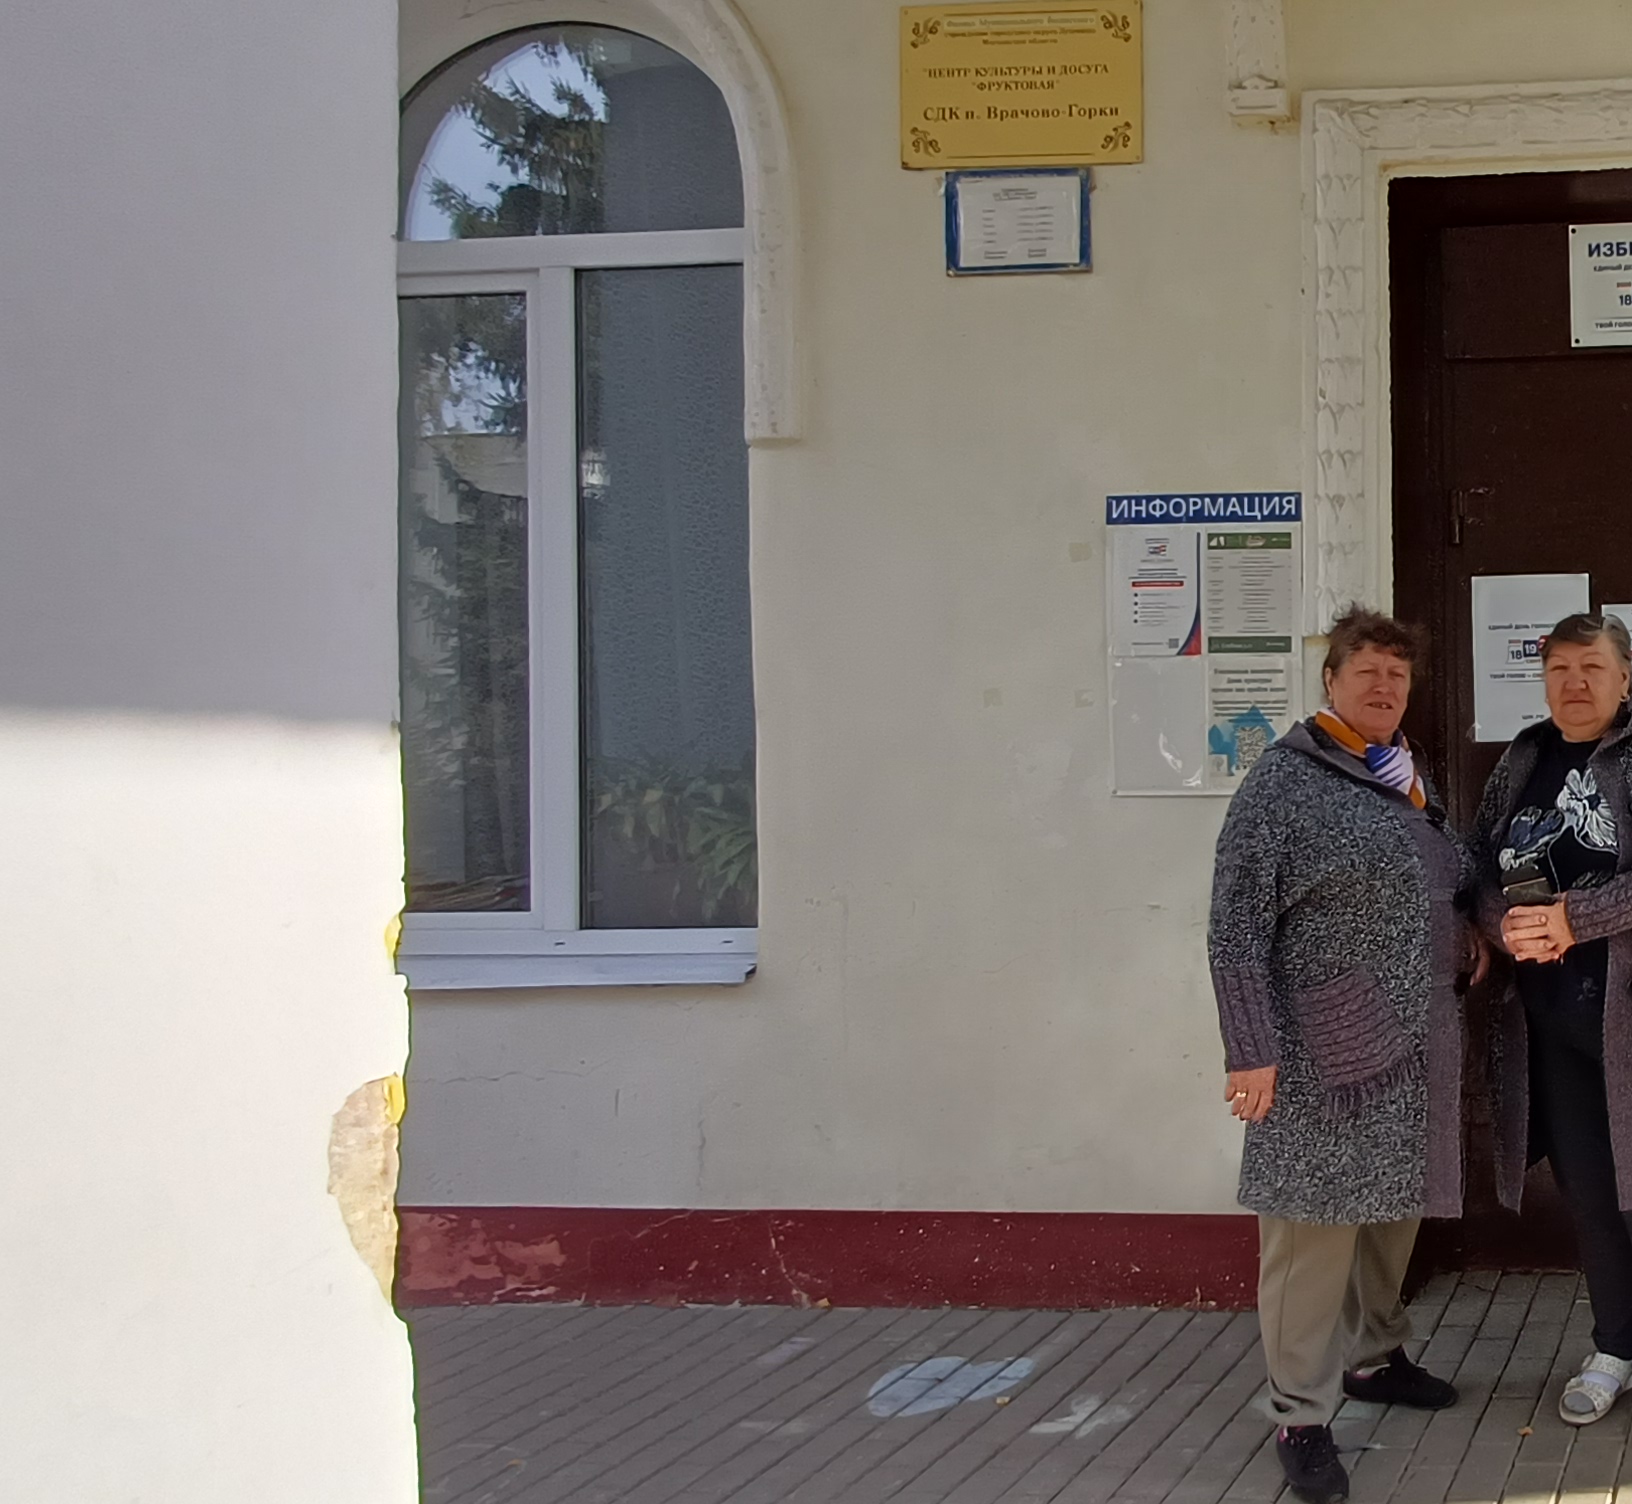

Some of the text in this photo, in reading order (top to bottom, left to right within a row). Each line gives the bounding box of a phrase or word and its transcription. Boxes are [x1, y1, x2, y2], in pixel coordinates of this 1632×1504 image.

[975, 65, 1043, 77] КУЛЬТУРЫ
[1047, 65, 1056, 75] И
[1059, 63, 1109, 76] ДОСУГА
[923, 106, 960, 122] СДК
[986, 104, 1119, 122] Врачово-Горки
[1618, 294, 1632, 306] 18
[1111, 496, 1296, 521] ИНФОРМАЦИЯ
[1510, 650, 1522, 660] 18
[1524, 643, 1537, 654] 19
